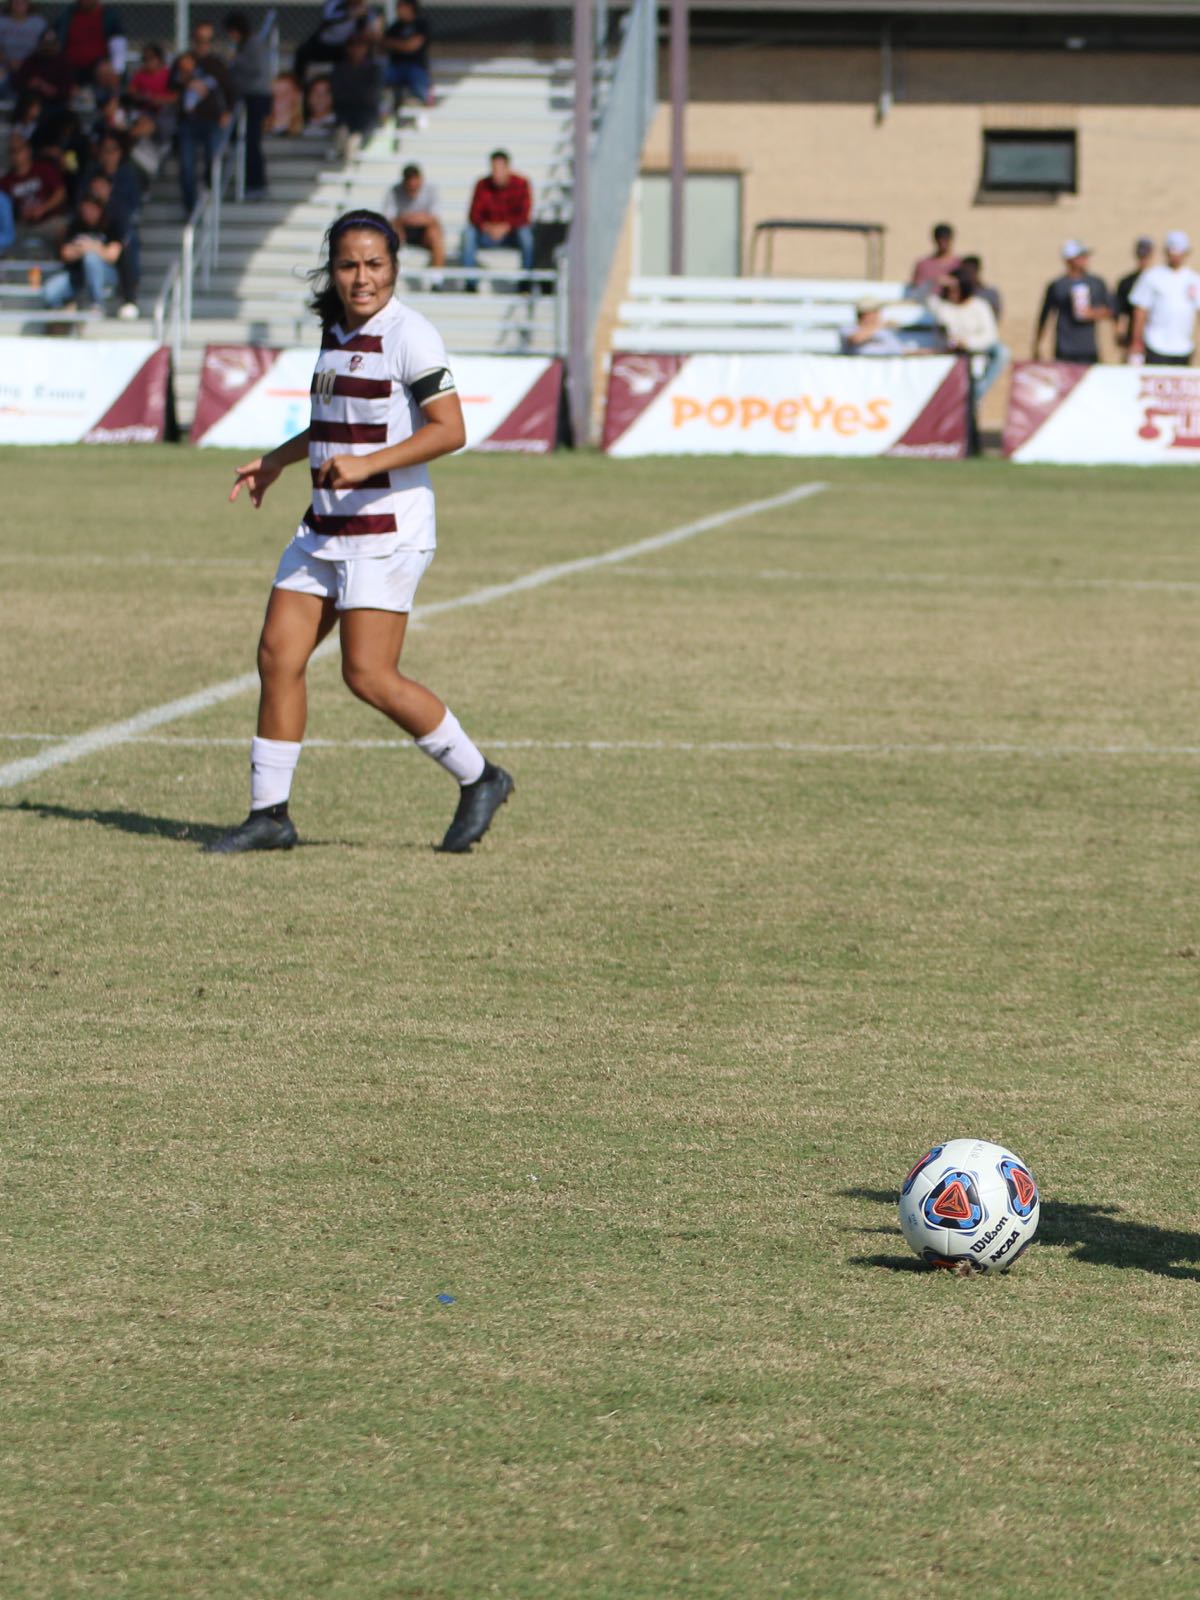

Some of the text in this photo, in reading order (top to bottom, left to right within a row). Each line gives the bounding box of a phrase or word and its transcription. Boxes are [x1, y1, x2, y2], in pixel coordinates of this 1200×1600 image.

[316, 368, 337, 406] 10
[970, 1216, 1009, 1253] Wilson
[990, 1230, 1021, 1263] NCAA
